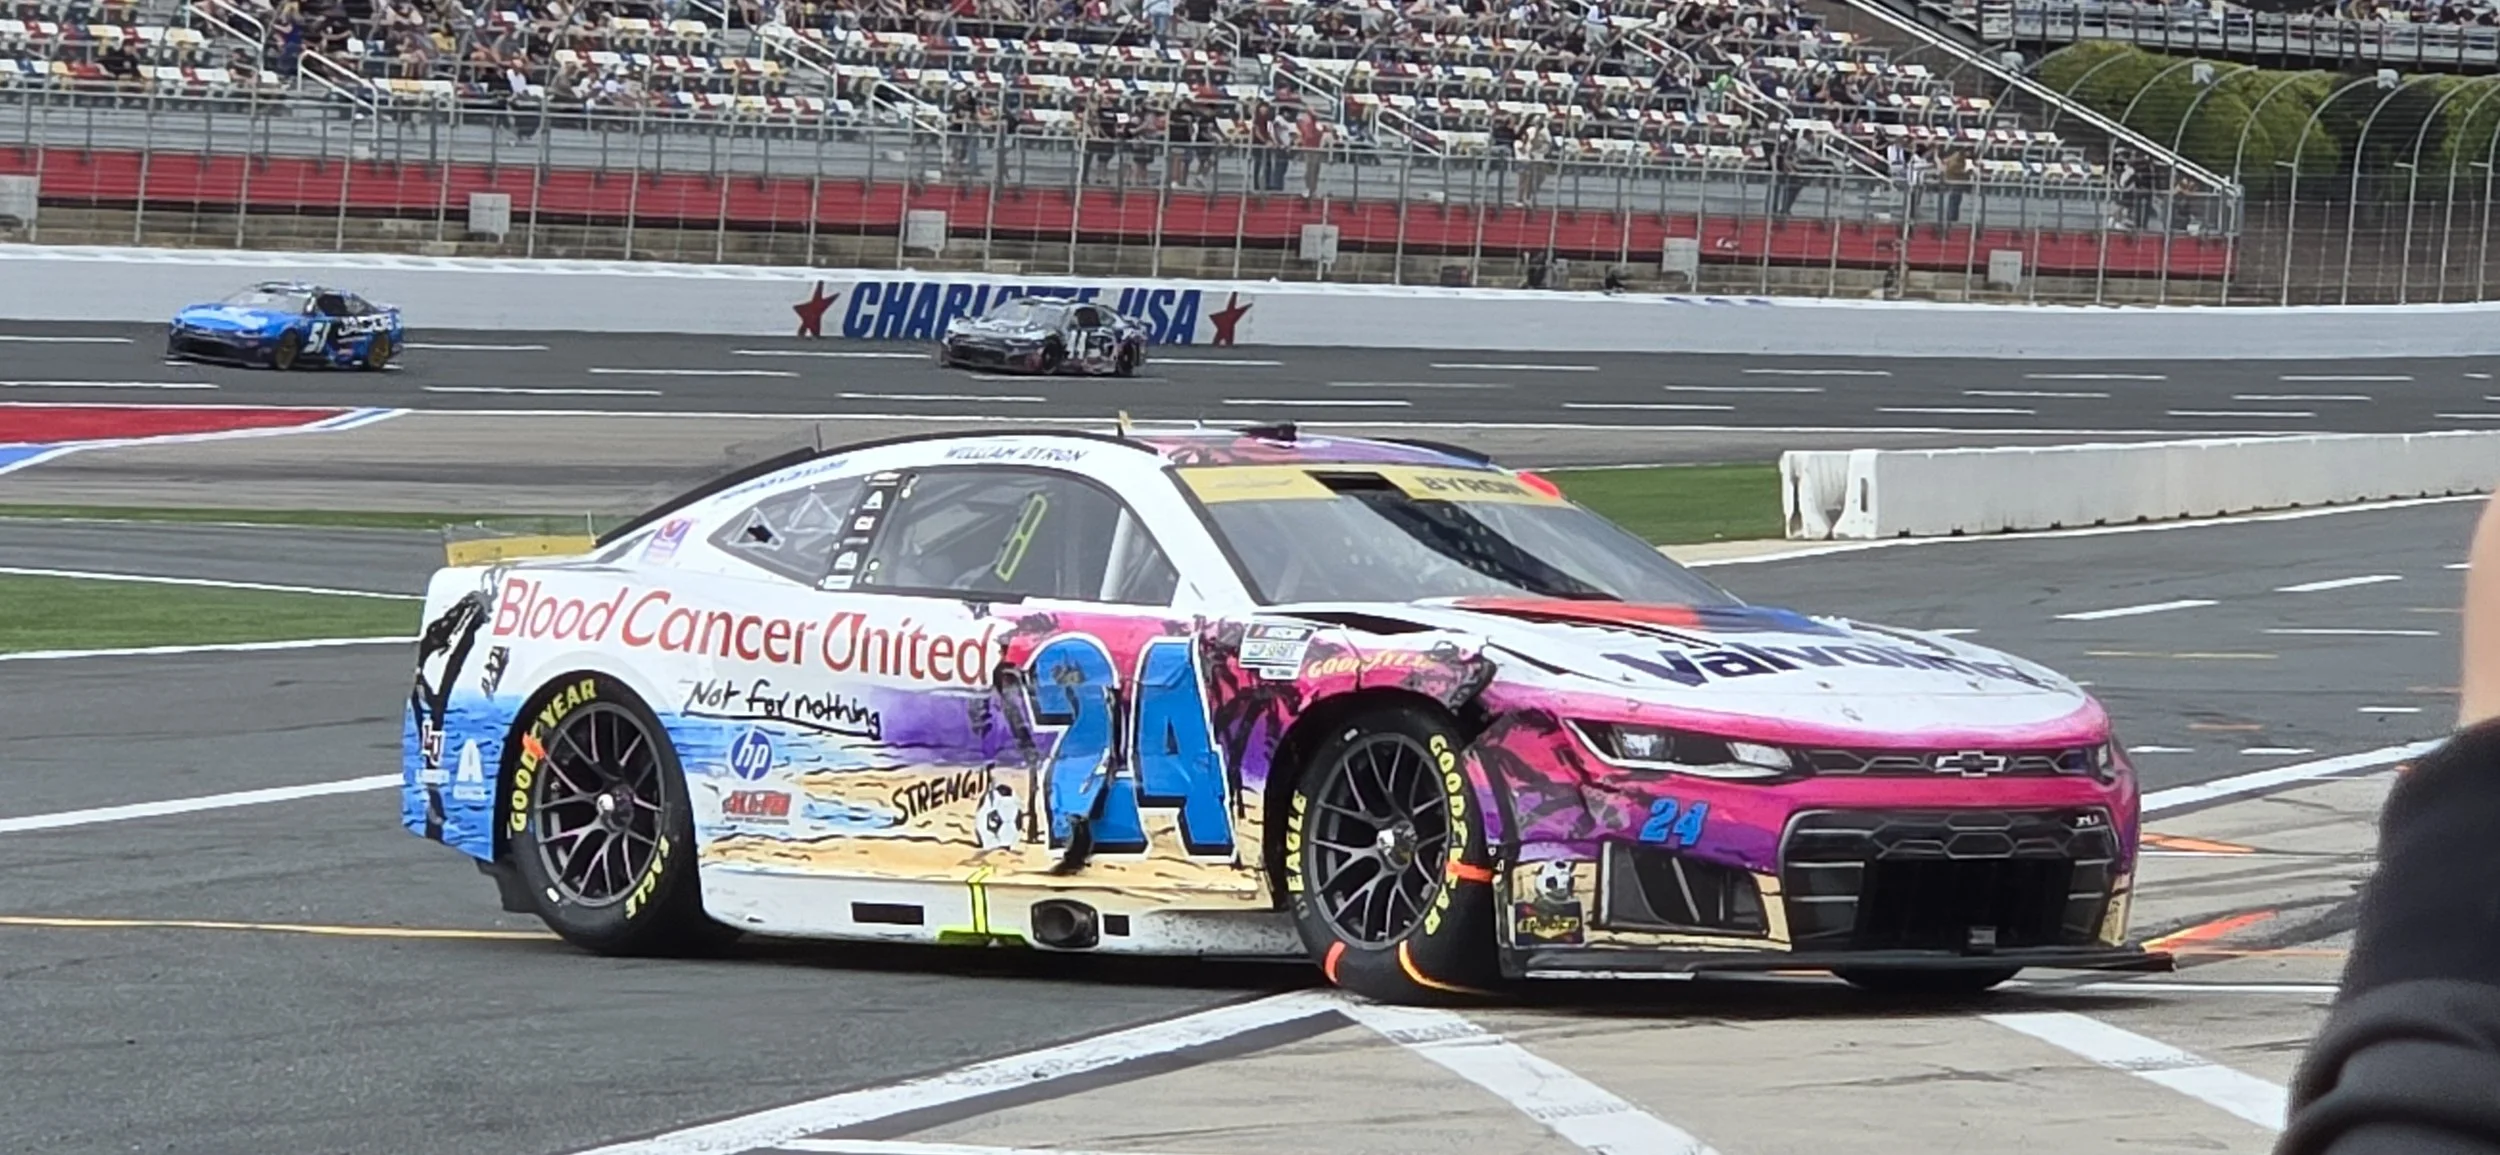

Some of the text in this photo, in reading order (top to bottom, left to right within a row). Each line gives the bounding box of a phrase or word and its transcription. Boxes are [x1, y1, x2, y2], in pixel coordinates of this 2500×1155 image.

[304, 321, 331, 353] 51
[843, 282, 1101, 340] CHARL
[1414, 476, 1532, 497] BYRON
[492, 578, 995, 685] Blood Cancer United
[1600, 642, 2048, 689] Valvoline
[687, 678, 881, 738] Not for nothing
[733, 731, 773, 780] hp
[1024, 632, 1237, 863] 24
[1285, 790, 1308, 892] EAGLE
[1638, 797, 1708, 847] 24
[625, 834, 670, 920] EAGLE
